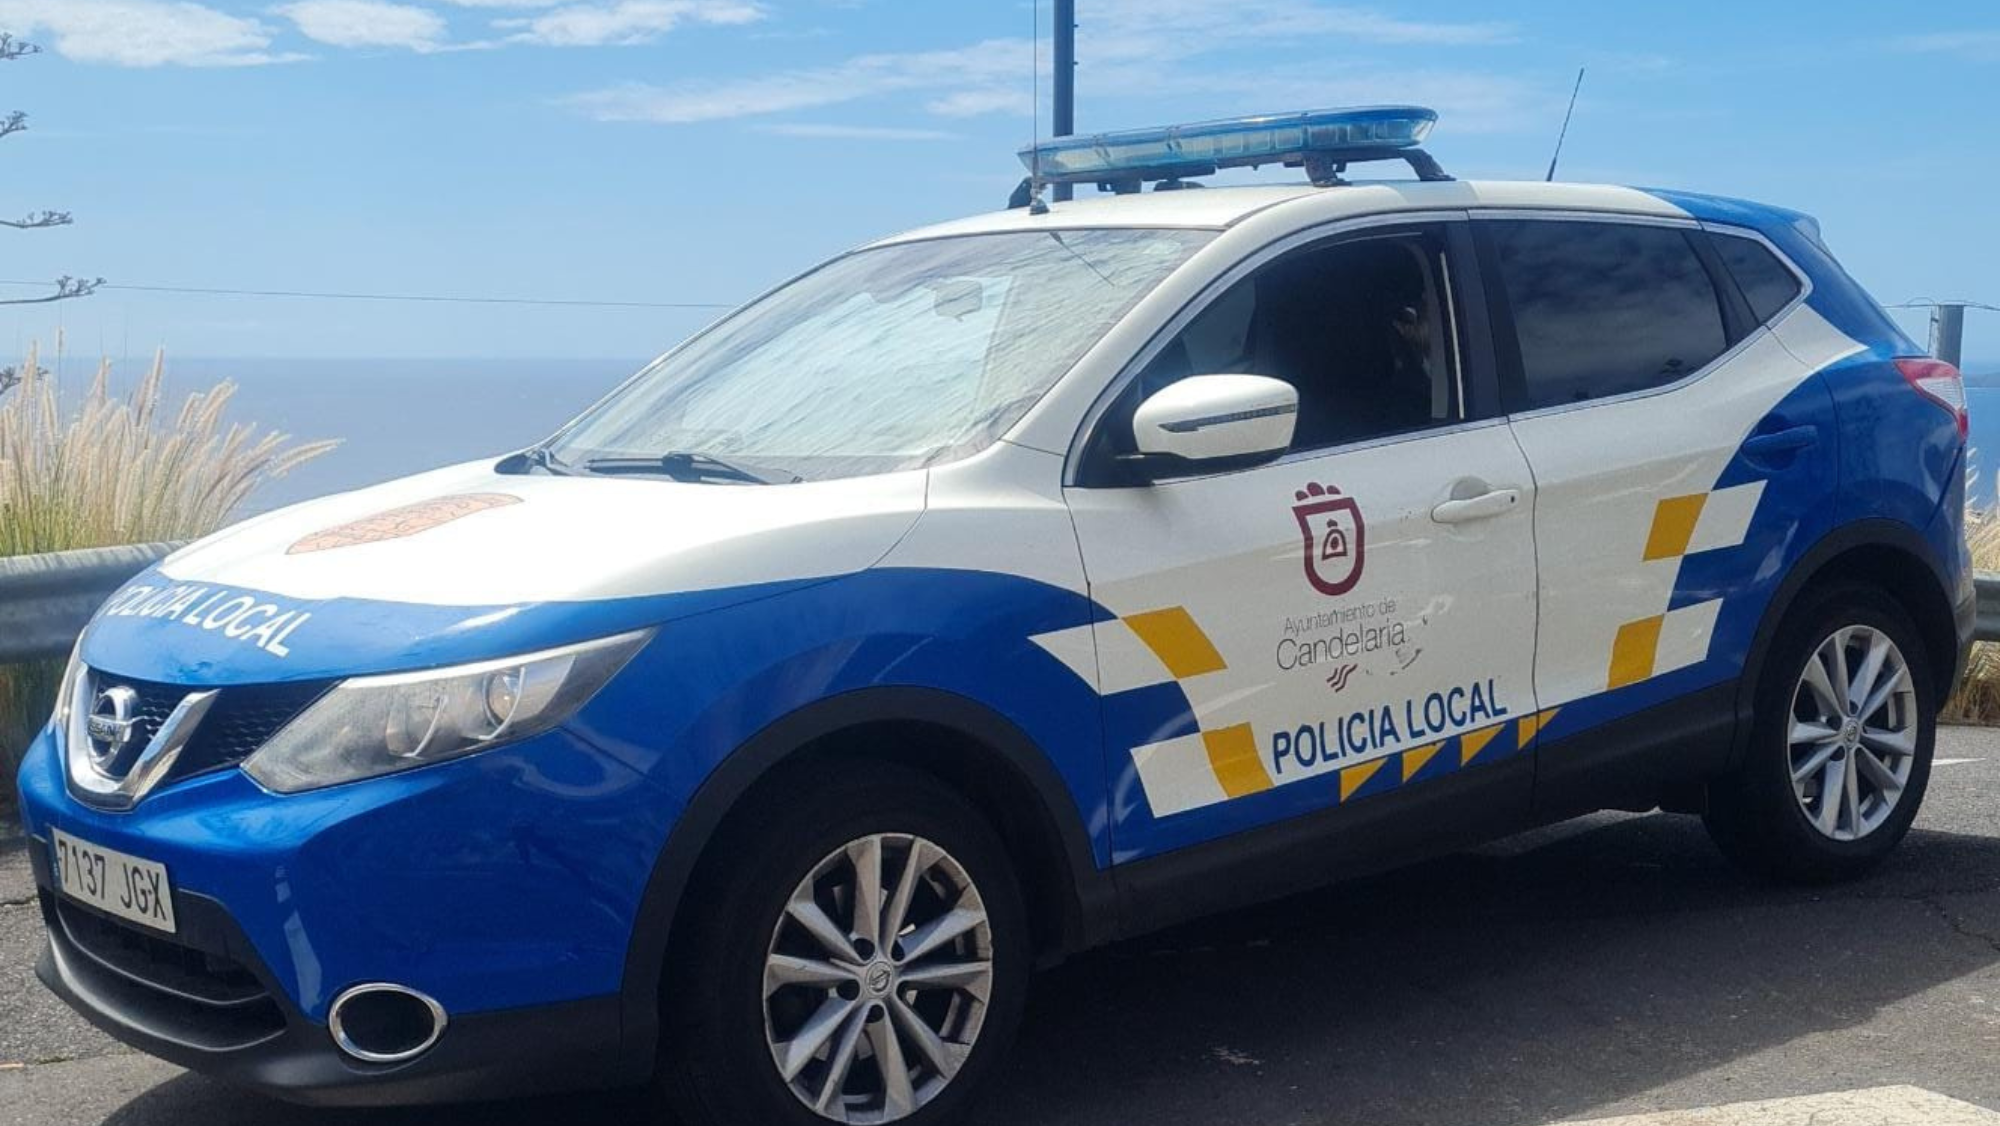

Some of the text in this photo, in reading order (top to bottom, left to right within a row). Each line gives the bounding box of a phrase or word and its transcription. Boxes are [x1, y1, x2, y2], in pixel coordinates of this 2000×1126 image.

[182, 590, 312, 658] LOCAL
[1276, 617, 1406, 670] Candelaria
[1284, 597, 1397, 637] Ayuntamiento de
[1272, 678, 1508, 775] POLICIA LOCAL
[58, 838, 167, 922] 7137 JGX
